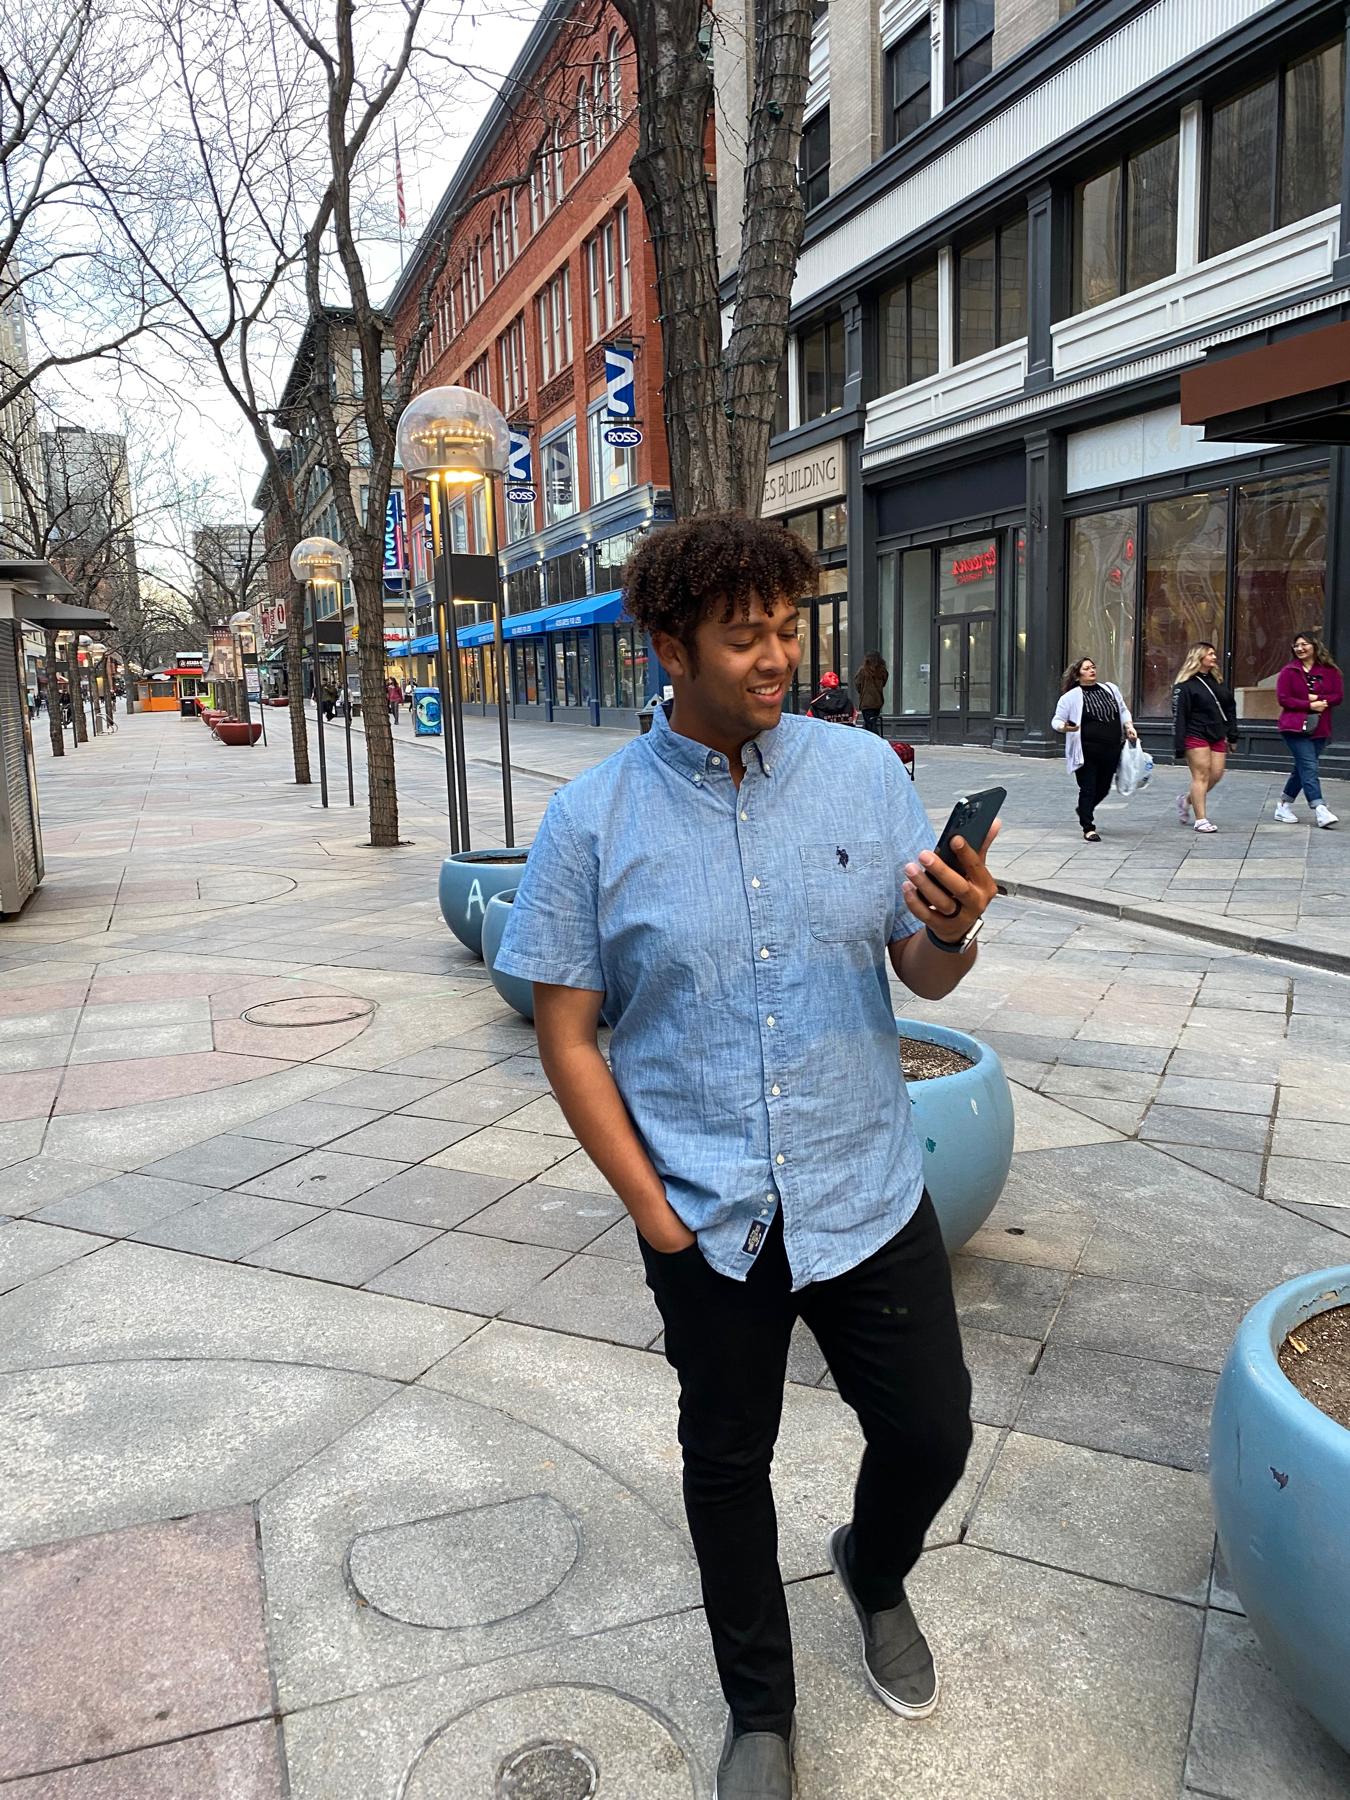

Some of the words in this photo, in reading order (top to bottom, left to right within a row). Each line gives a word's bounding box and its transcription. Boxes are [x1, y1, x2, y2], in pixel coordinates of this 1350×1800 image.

[607, 431, 638, 443] ROSS
[763, 478, 776, 502] ES
[778, 456, 836, 497] BUILDING
[509, 491, 534, 501] ROSS
[465, 878, 486, 922] A
